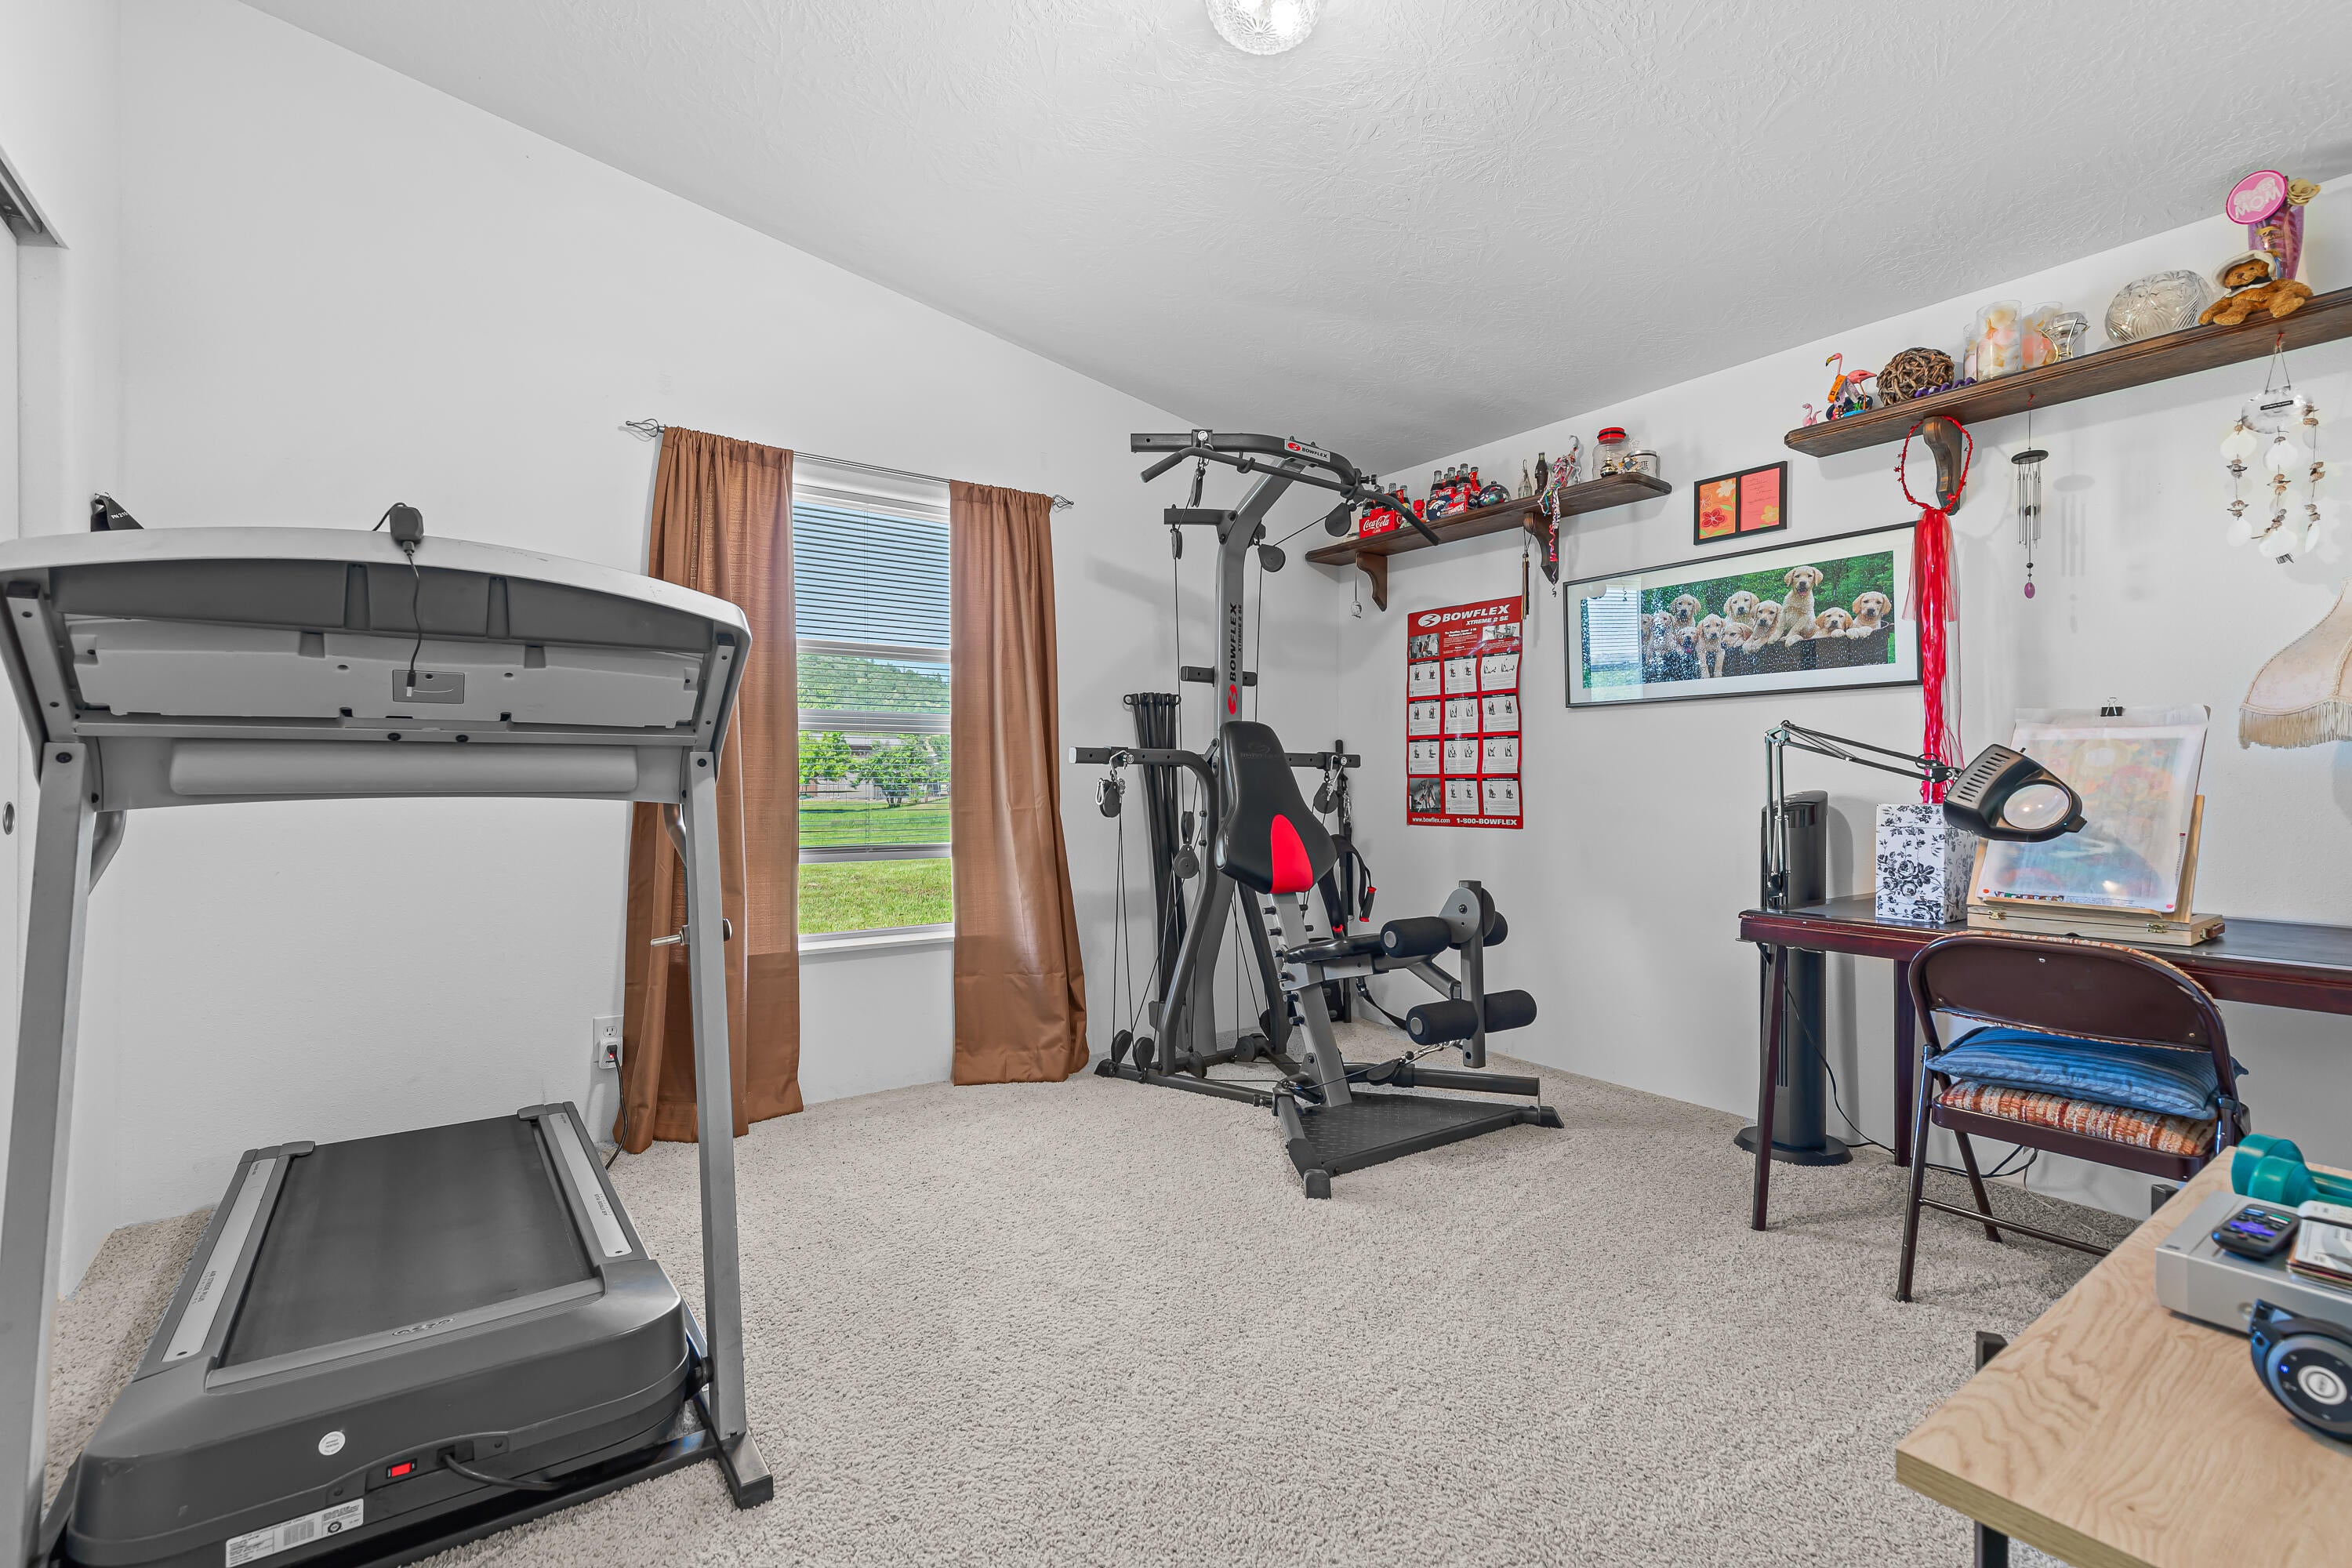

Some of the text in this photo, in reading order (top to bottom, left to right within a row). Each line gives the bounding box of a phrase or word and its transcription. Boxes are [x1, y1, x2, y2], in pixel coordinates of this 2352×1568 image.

[1301, 447, 1327, 458] BOWFLEX
[1363, 514, 1391, 532] Coca-Cola
[1442, 604, 1510, 622] BOWFLEX
